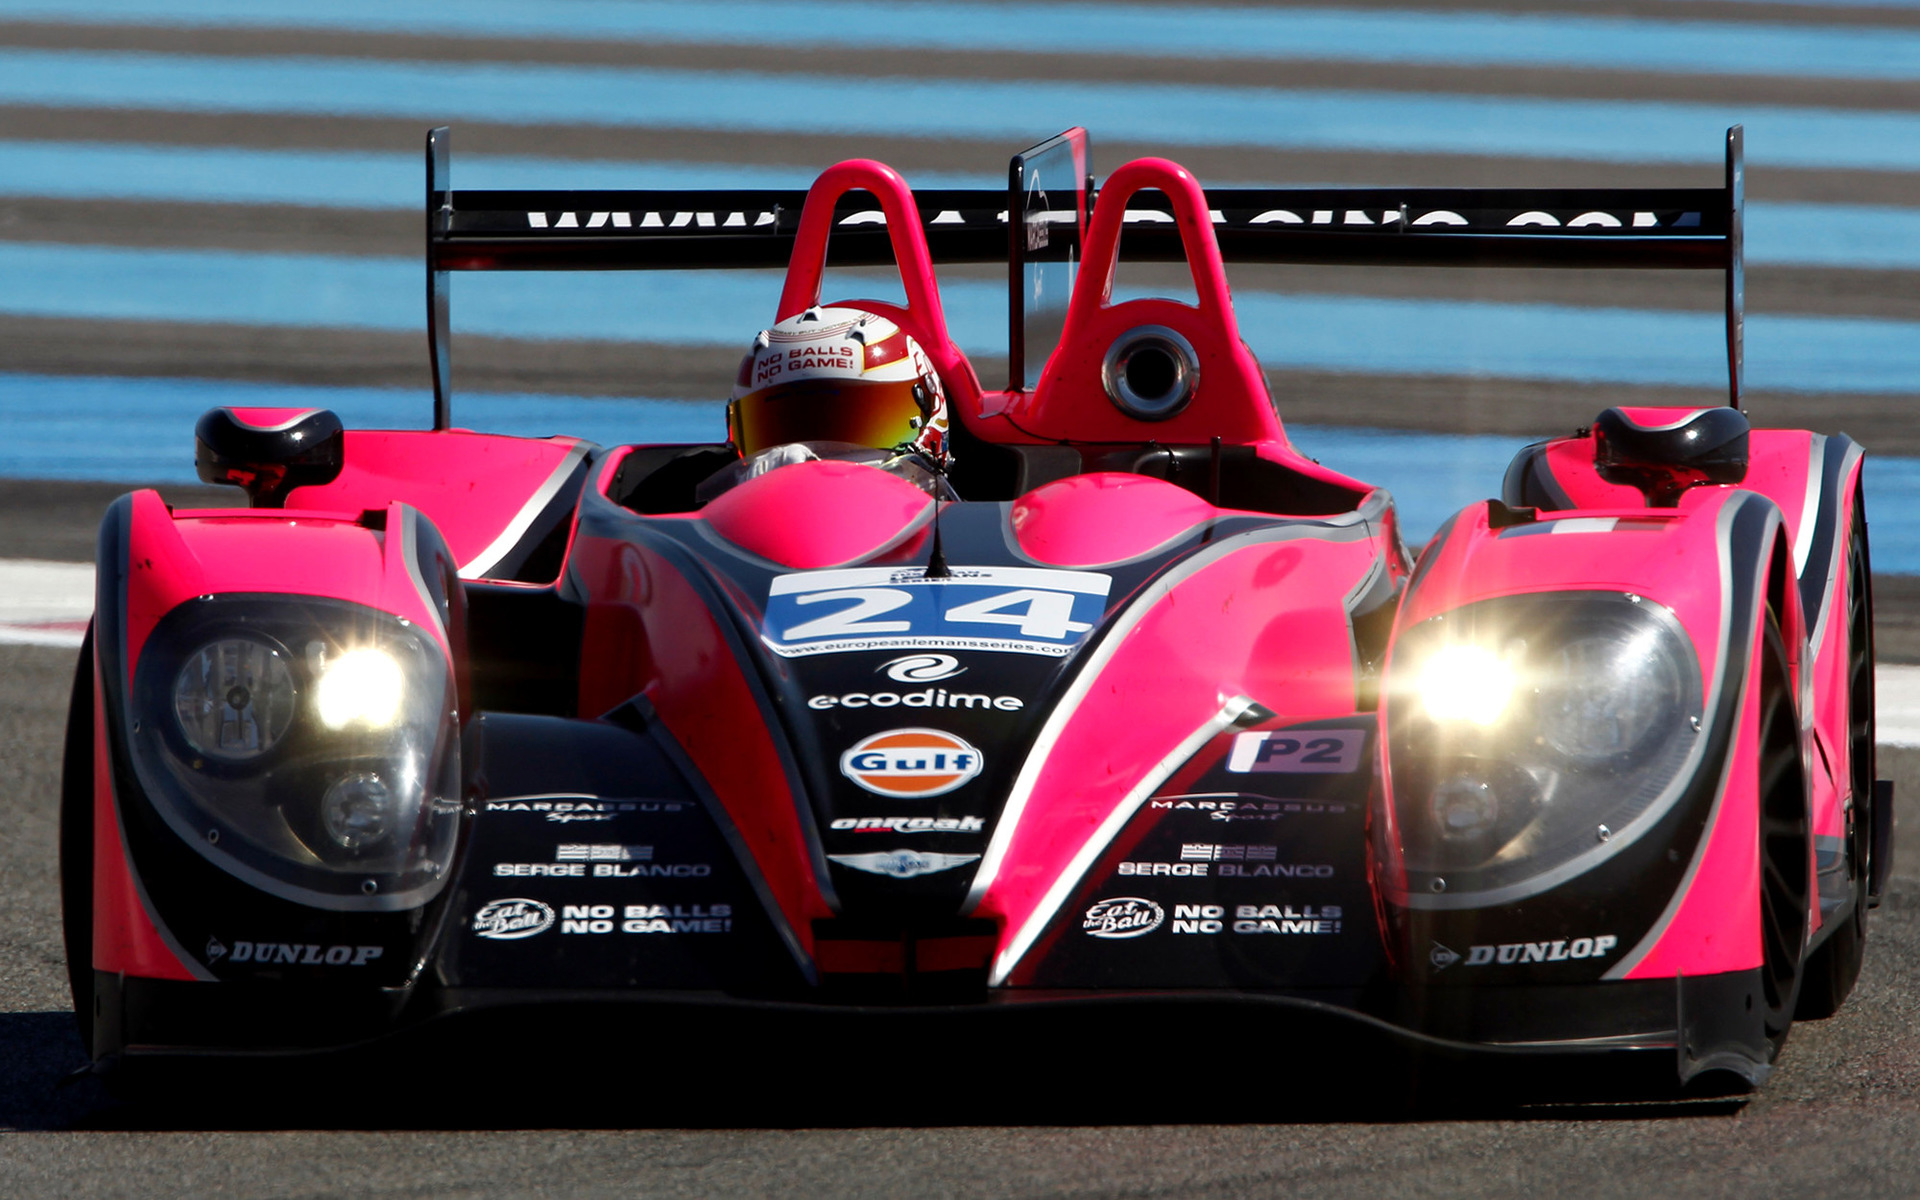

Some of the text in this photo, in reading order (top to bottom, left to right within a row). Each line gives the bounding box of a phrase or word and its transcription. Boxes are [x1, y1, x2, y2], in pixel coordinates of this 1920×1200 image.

[758, 346, 853, 370] NO BALLS
[757, 358, 854, 383] NO GAME!
[782, 587, 1093, 640] 24
[807, 688, 1024, 711] ecodime
[1256, 737, 1345, 764] P2
[850, 752, 974, 770] Gulf
[486, 802, 682, 812] MARCASSUS
[1151, 800, 1346, 813] MARCASSUS
[493, 863, 711, 877] SERGE BLANCO
[1118, 862, 1334, 878] SERGE BLANCO
[476, 903, 529, 920] Eat
[561, 905, 732, 919] NO BALLS
[1086, 901, 1139, 919] Eat
[1174, 904, 1343, 919] NO BALLS
[489, 912, 544, 932] Ball
[561, 920, 732, 934] NO GAME!
[1101, 910, 1153, 932] Ball
[1172, 920, 1342, 934] NO GAME!
[228, 941, 384, 966] DUNLOP
[1464, 934, 1618, 966] DUNLOP
